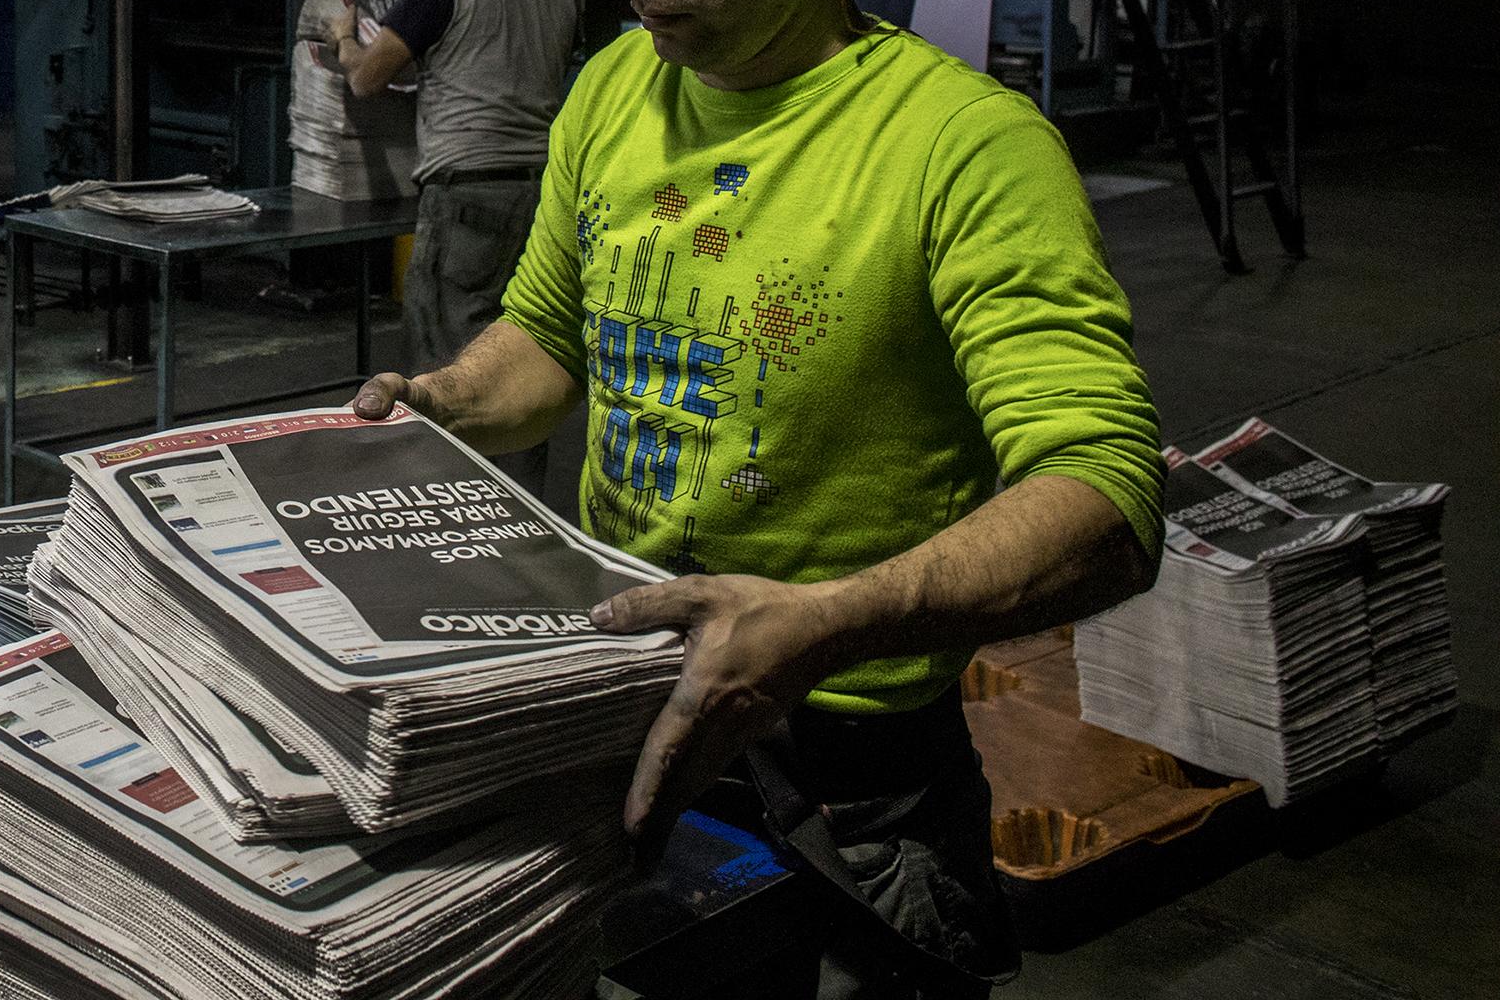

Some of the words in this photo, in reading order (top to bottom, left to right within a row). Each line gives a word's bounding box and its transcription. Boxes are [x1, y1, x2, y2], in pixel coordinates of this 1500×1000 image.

[582, 300, 744, 419] AME
[276, 478, 513, 520] RESISTIENDO
[327, 508, 441, 531] SEGUIR
[440, 501, 512, 524] PARA
[303, 519, 554, 555] TRANSFORMAMOS
[5, 554, 34, 563] NO
[430, 543, 503, 564] NOS
